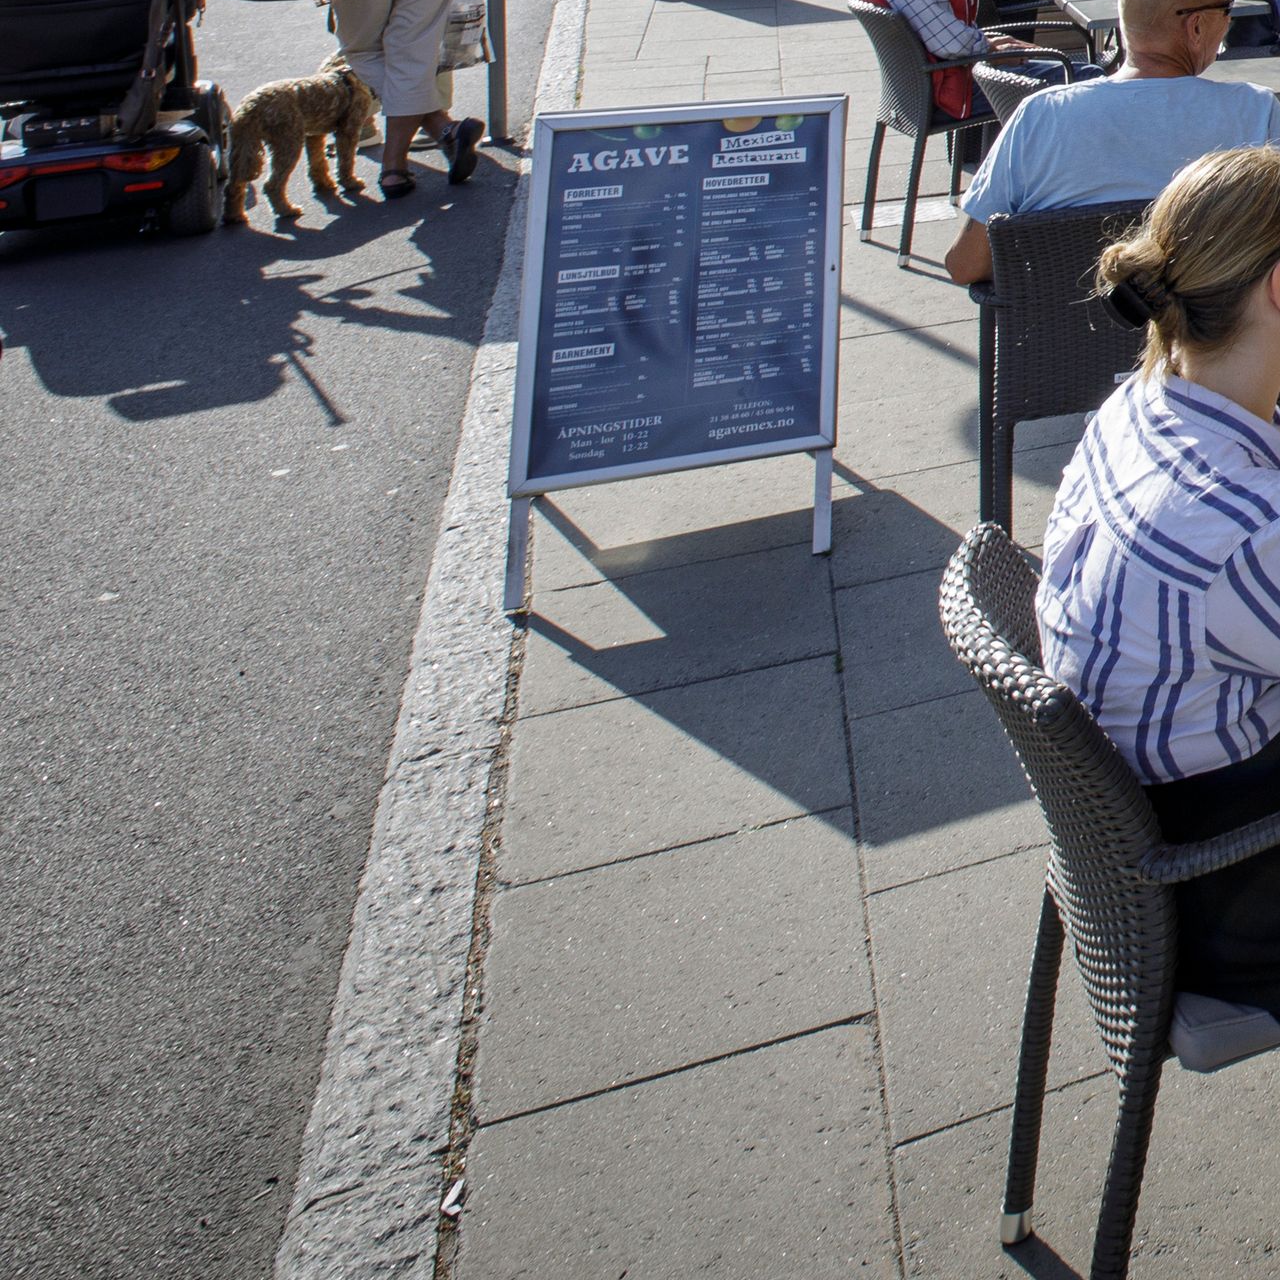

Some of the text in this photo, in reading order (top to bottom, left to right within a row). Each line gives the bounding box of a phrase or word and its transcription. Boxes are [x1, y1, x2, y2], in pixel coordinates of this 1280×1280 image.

[725, 132, 793, 149] Mexican
[567, 144, 689, 173] AGAVE
[715, 150, 800, 165] Restaurant
[705, 176, 767, 188] HOVEDRETTER
[566, 187, 619, 200] FORRETTER
[560, 268, 618, 281] LUNSJTILBUD
[555, 346, 611, 360] BARNEMENY
[557, 415, 662, 440] ÅPNINGSTIDER
[708, 417, 795, 440] agavemex.no
[570, 439, 592, 449] Man
[623, 430, 649, 441] 10-22
[568, 441, 649, 460] Søndag 12-22
